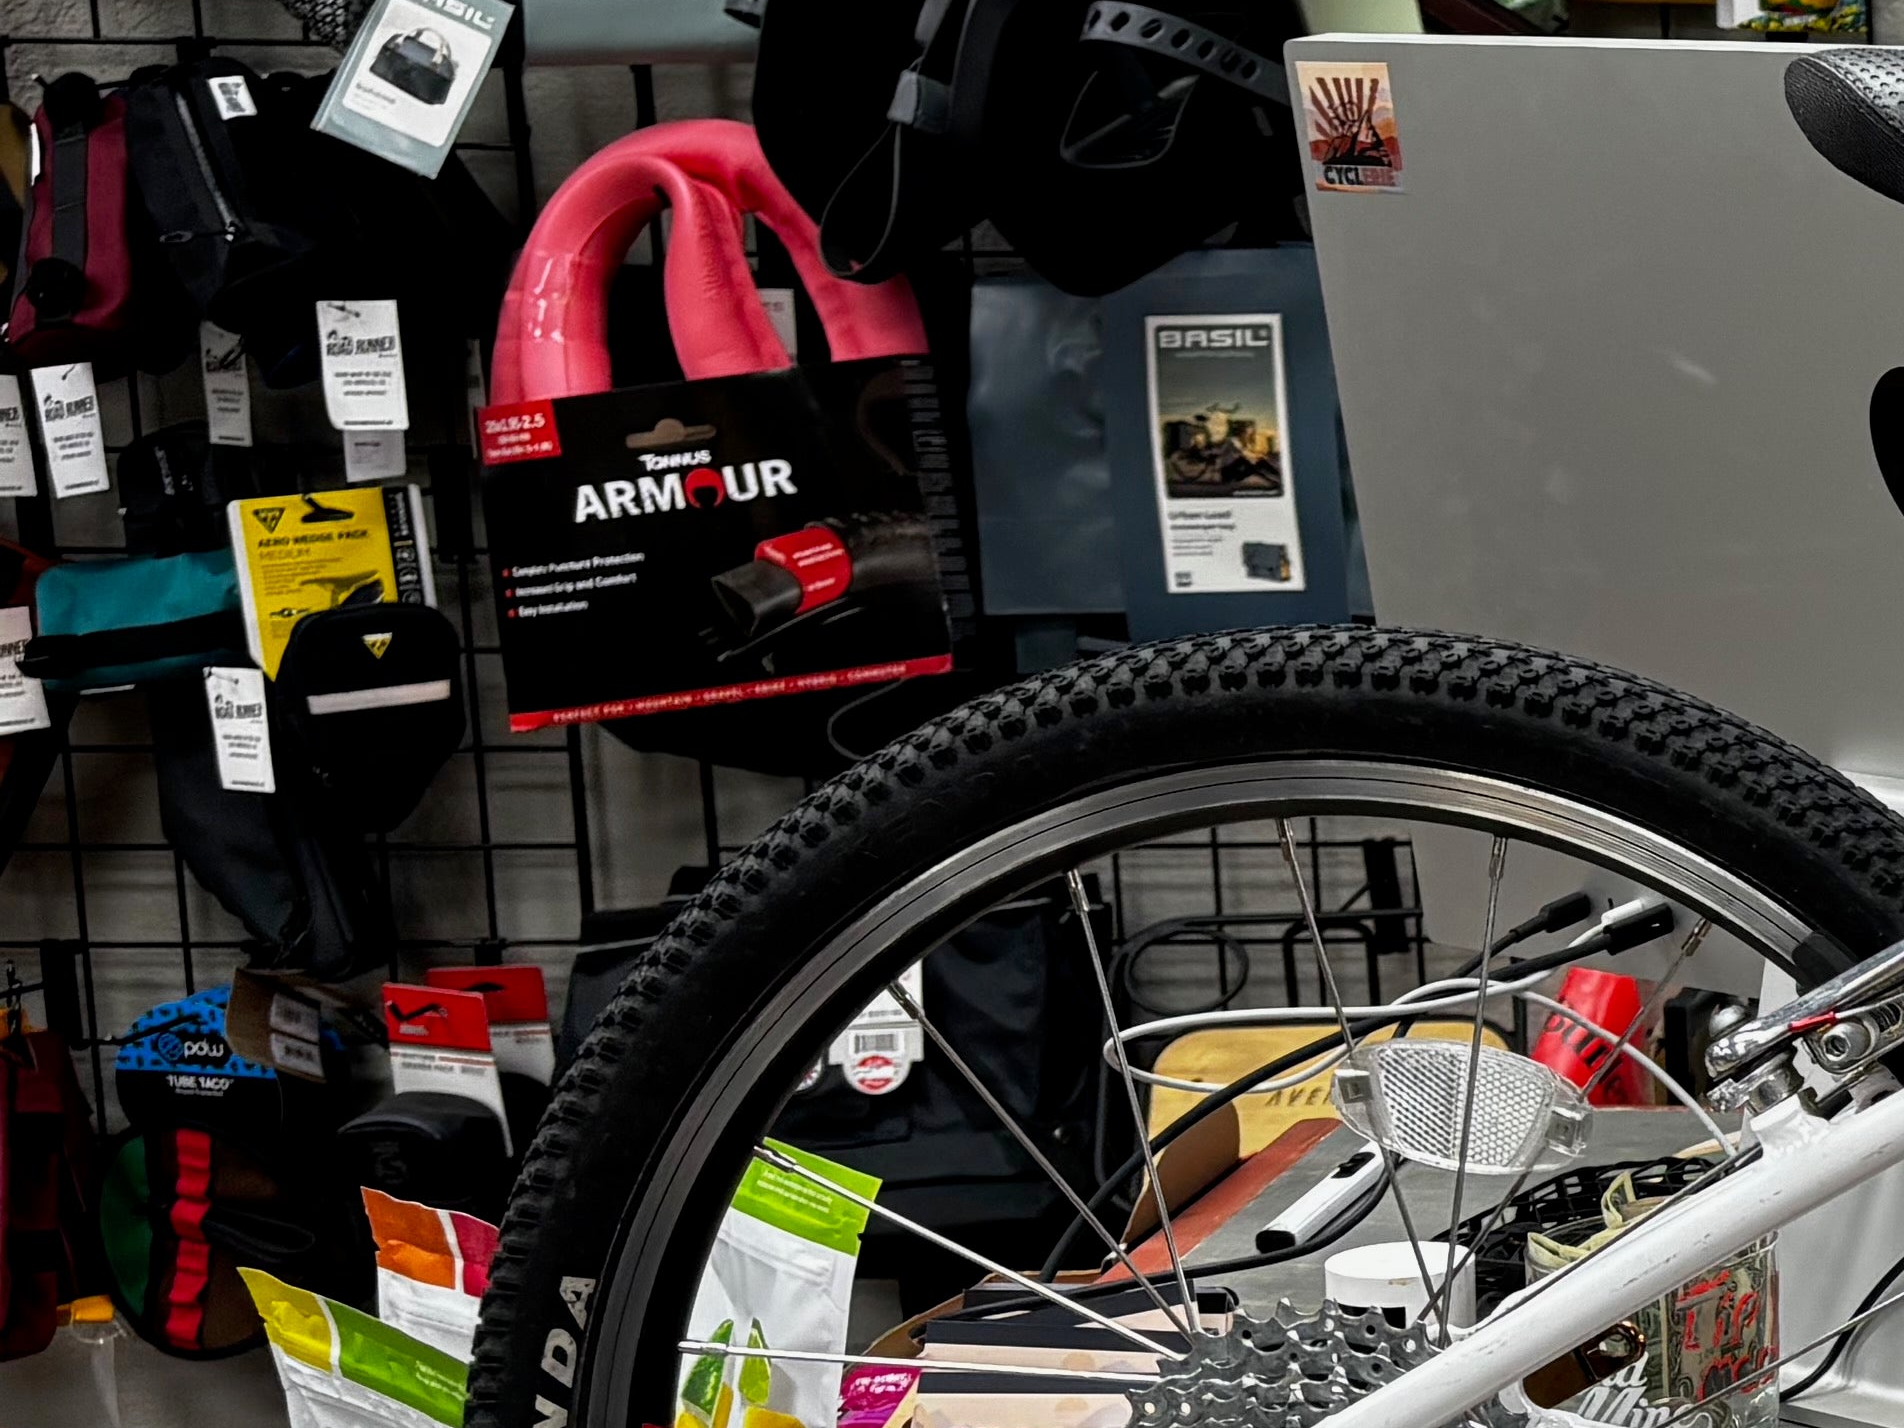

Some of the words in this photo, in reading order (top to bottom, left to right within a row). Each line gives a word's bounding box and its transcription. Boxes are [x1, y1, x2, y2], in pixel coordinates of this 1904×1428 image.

[1159, 328, 1271, 349] BASIL
[574, 458, 798, 524] ARMOUR
[183, 1037, 225, 1059] pdw
